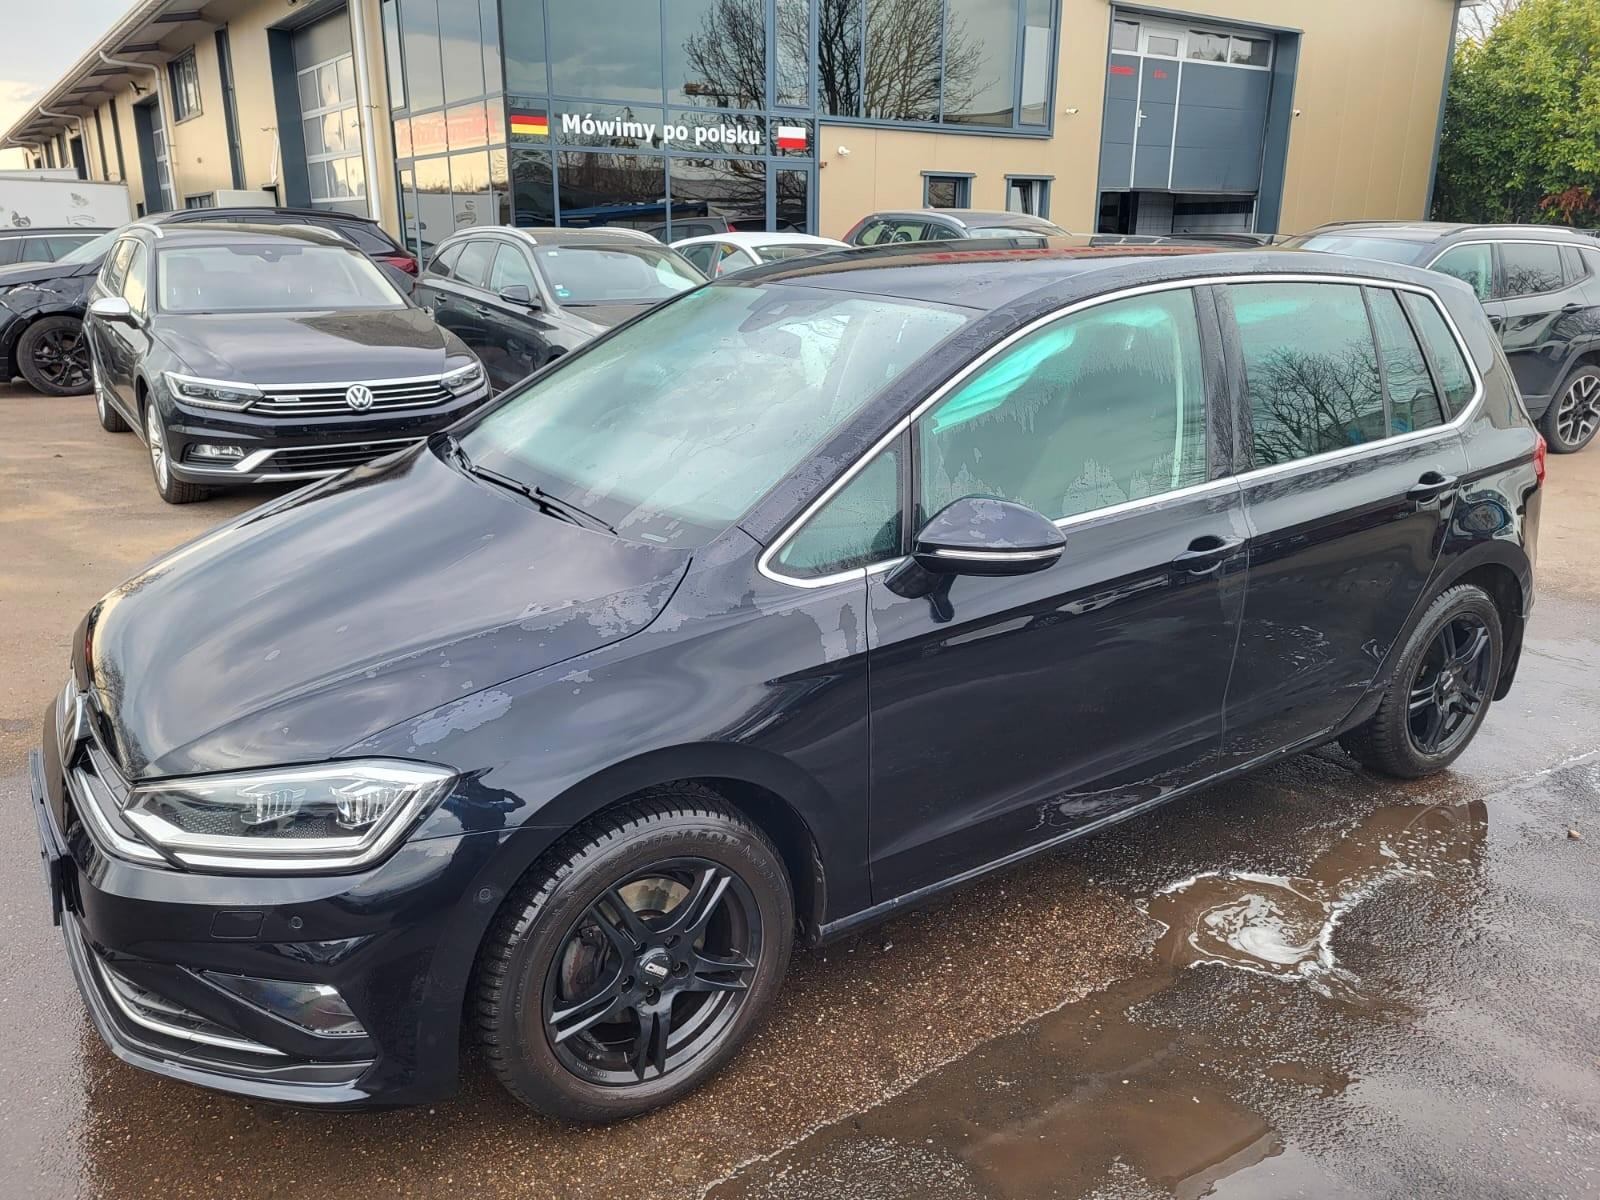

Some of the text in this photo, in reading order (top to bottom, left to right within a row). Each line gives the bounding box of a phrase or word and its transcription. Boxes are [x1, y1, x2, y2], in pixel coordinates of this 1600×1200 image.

[561, 112, 761, 145] Mówimy po polsku
